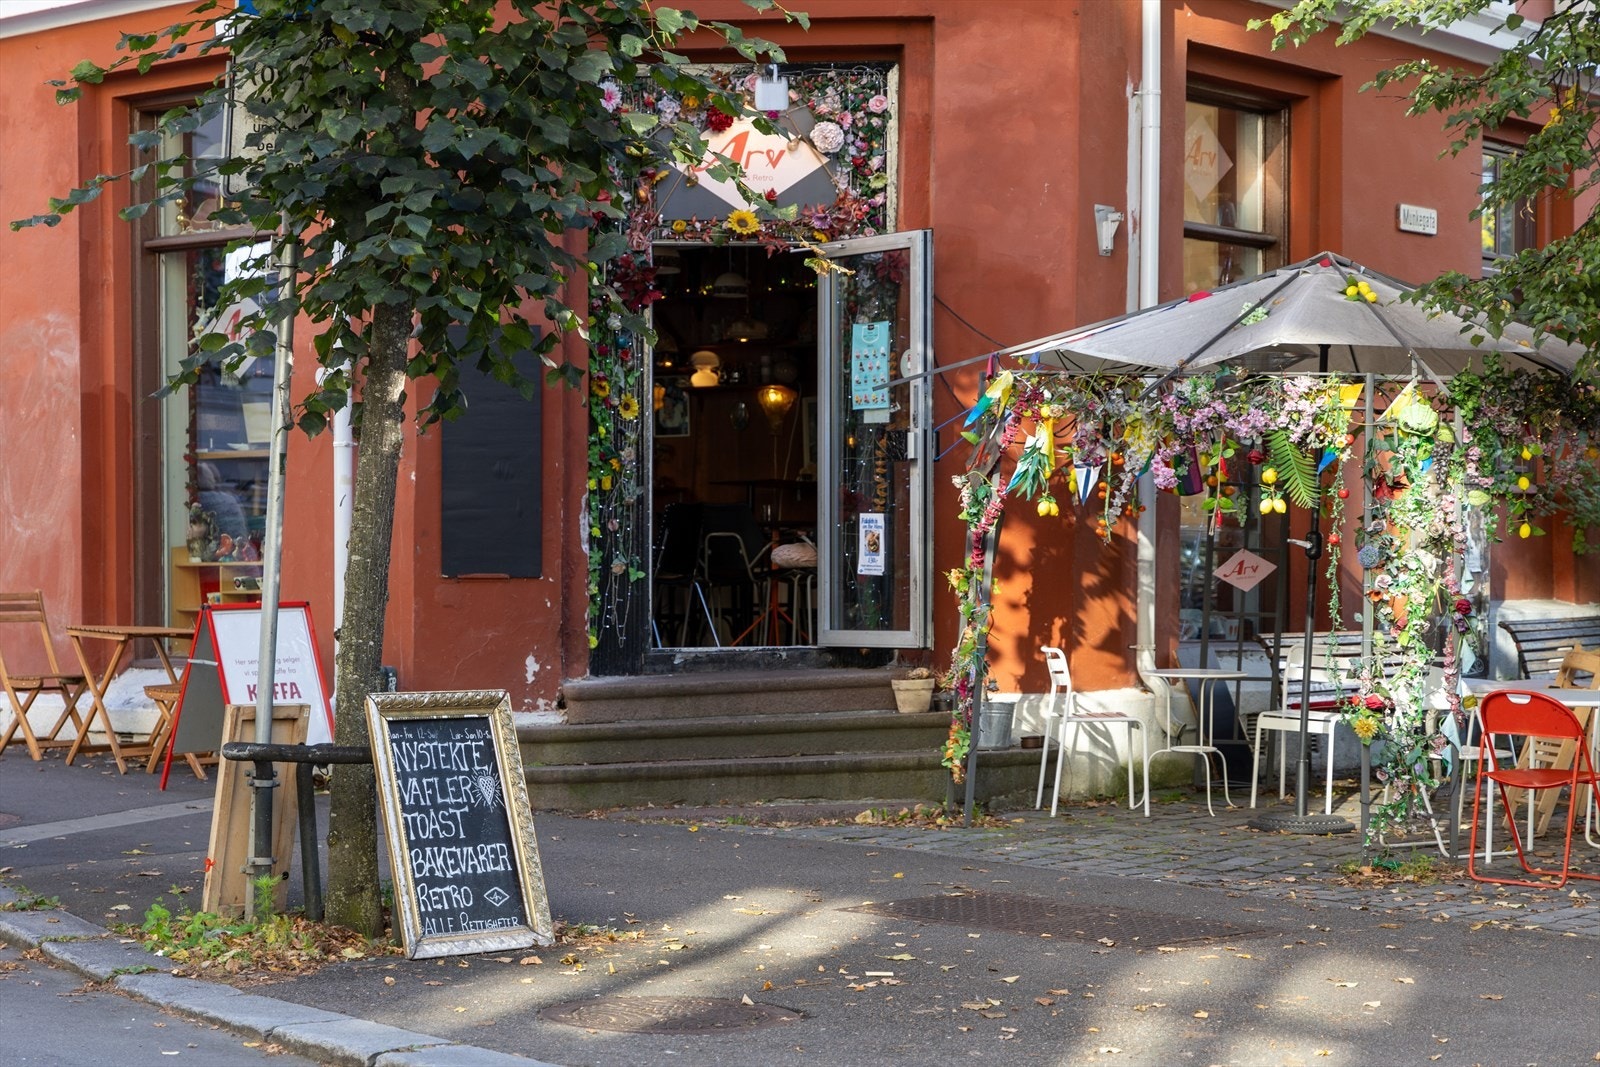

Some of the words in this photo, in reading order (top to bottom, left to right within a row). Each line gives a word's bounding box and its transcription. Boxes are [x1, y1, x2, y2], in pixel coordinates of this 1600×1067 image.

[690, 131, 786, 172] Arv
[1185, 135, 1217, 168] Arv
[1402, 208, 1436, 230] Munkegata
[1223, 559, 1259, 578] Arv
[283, 656, 300, 664] selger
[247, 682, 302, 701] KFFA
[392, 741, 489, 772] NYSTEKTE
[397, 775, 475, 806] VAFLER
[402, 805, 469, 840] TOAST
[411, 843, 512, 878] BAKEVARER
